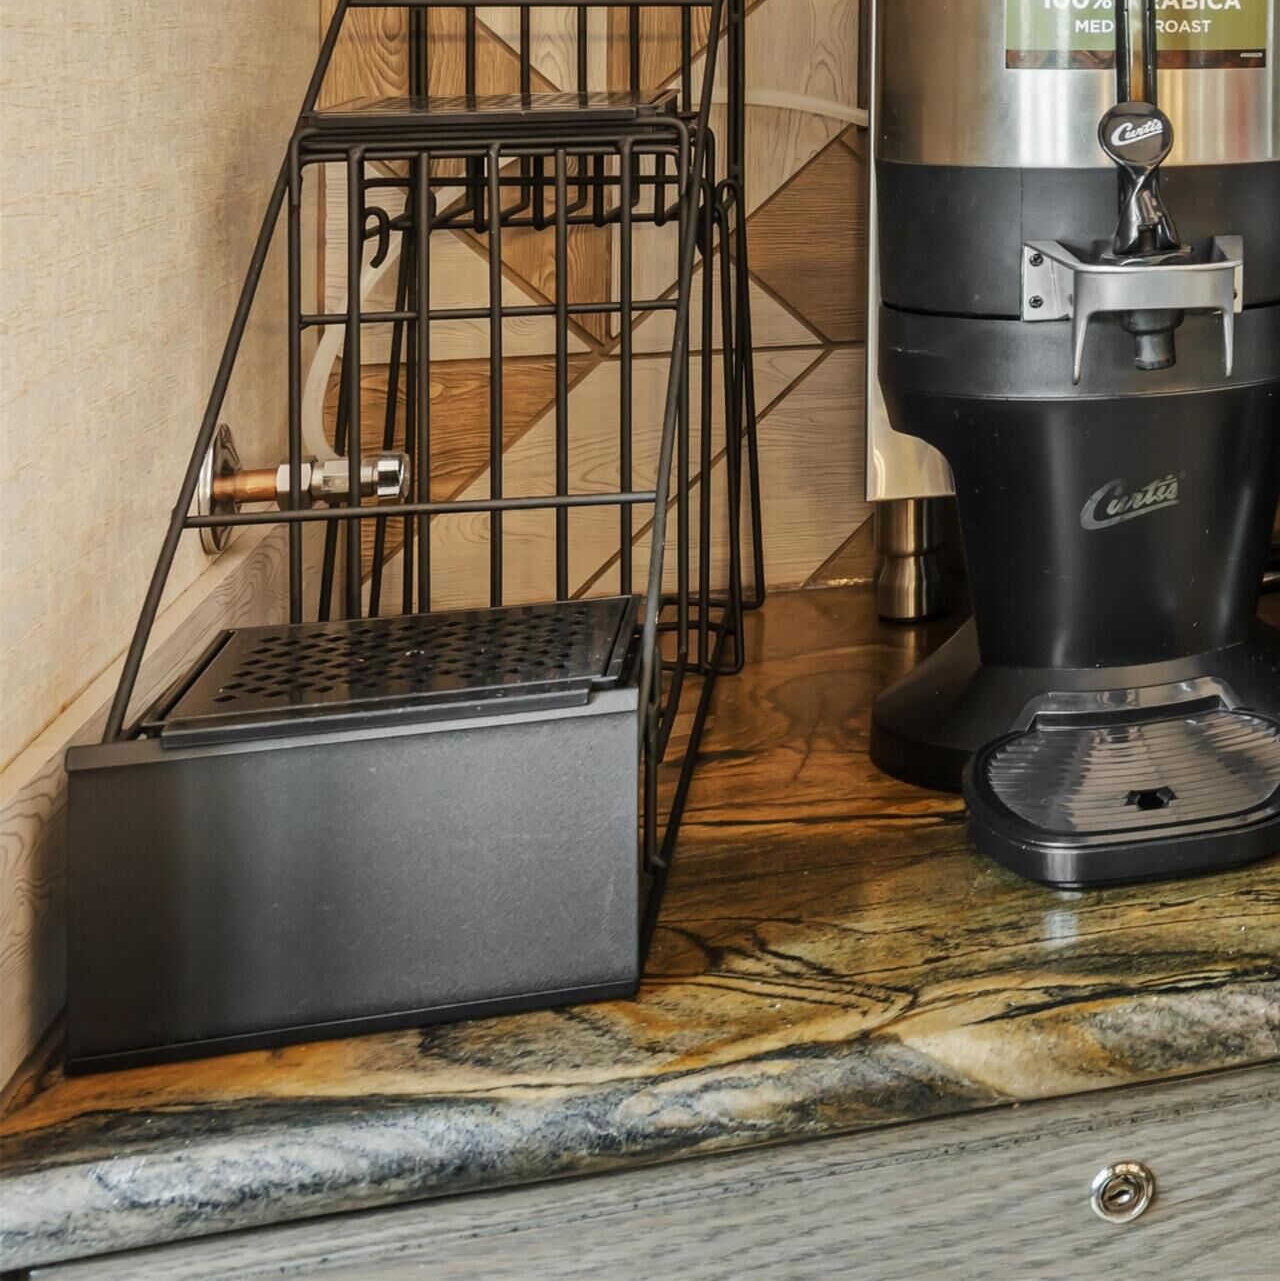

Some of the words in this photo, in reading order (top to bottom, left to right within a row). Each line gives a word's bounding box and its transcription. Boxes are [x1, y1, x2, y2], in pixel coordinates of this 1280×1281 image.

[1155, 20, 1212, 33] ROAST
[1110, 119, 1165, 147] Curtis
[1080, 475, 1180, 530] Curtis
